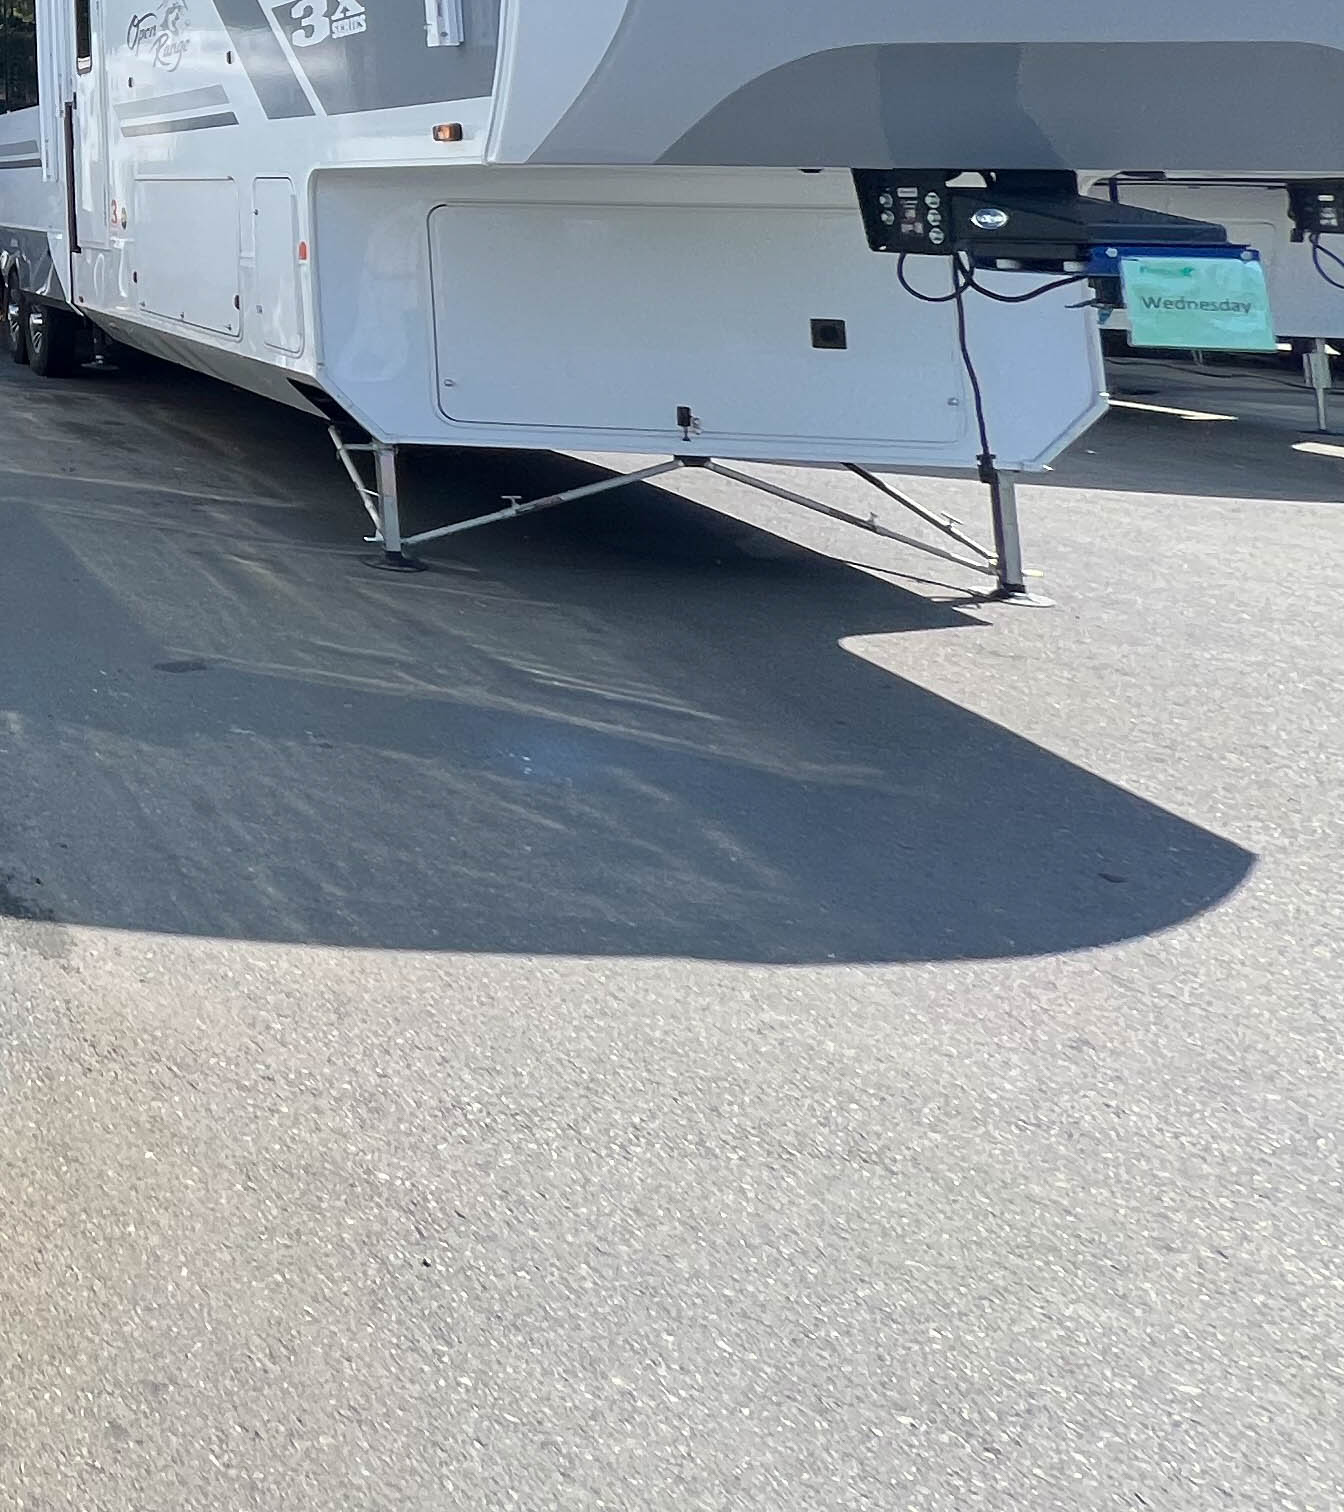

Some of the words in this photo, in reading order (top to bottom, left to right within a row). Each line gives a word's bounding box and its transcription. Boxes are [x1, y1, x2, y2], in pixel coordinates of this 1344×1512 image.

[126, 12, 158, 57] Open
[149, 32, 191, 73] Range
[1140, 295, 1252, 314] Wednesday
